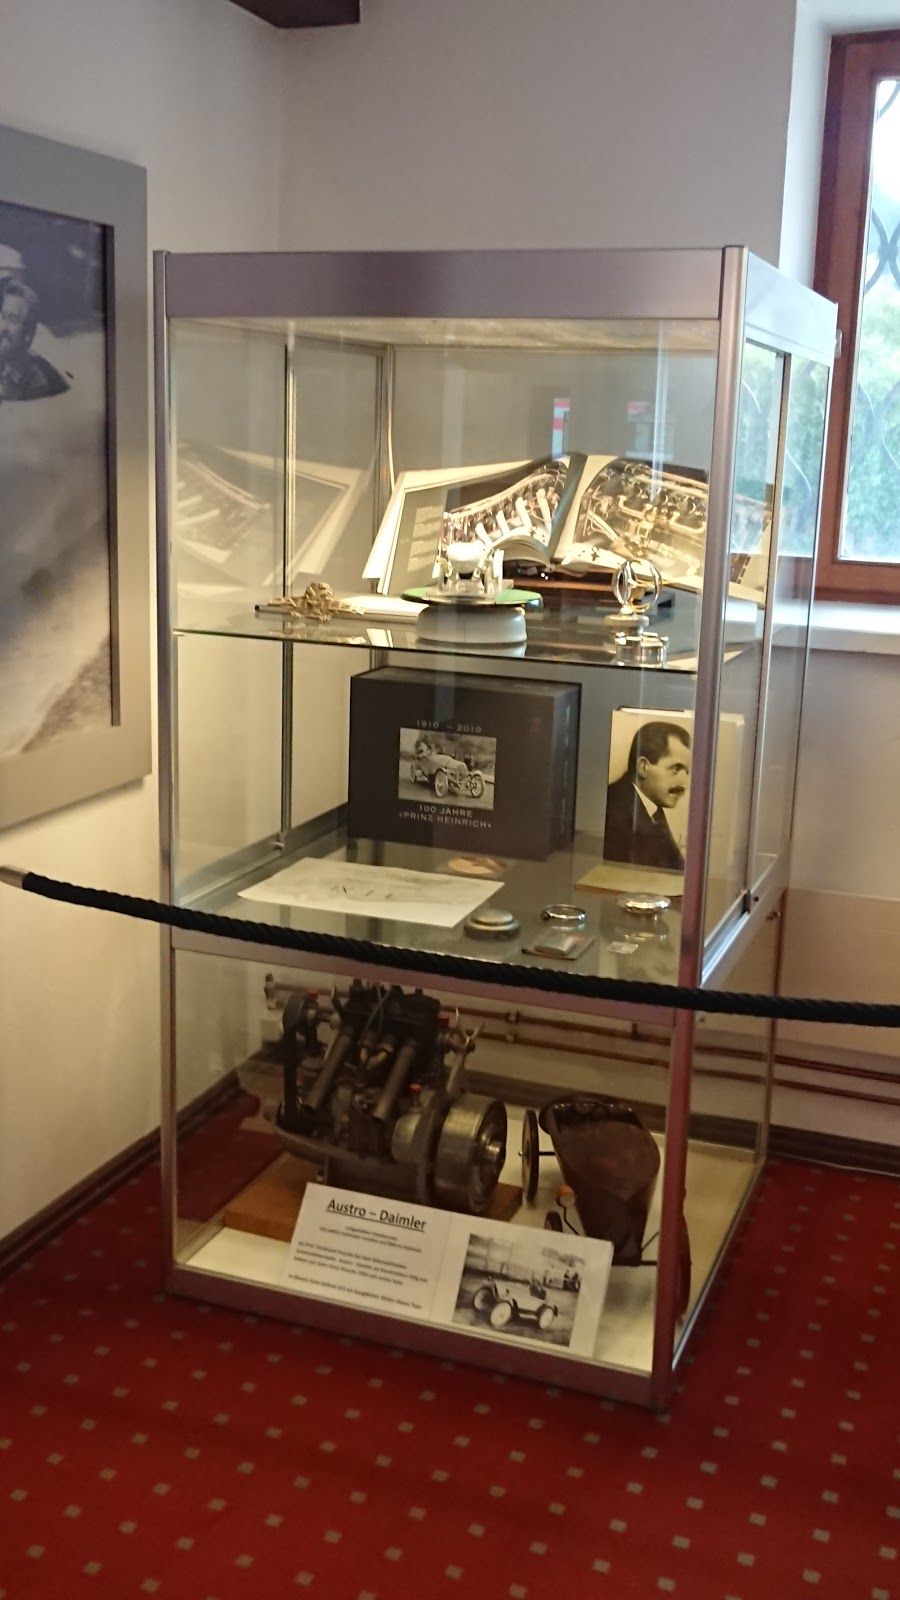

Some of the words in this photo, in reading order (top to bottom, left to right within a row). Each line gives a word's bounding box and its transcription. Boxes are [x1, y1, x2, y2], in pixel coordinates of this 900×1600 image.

[417, 720, 440, 729] 1910
[456, 724, 482, 734] 2010
[419, 804, 437, 814] 100
[439, 807, 473, 818] JAHRE
[327, 1199, 367, 1217] Austro
[379, 1209, 427, 1230] Daimler
